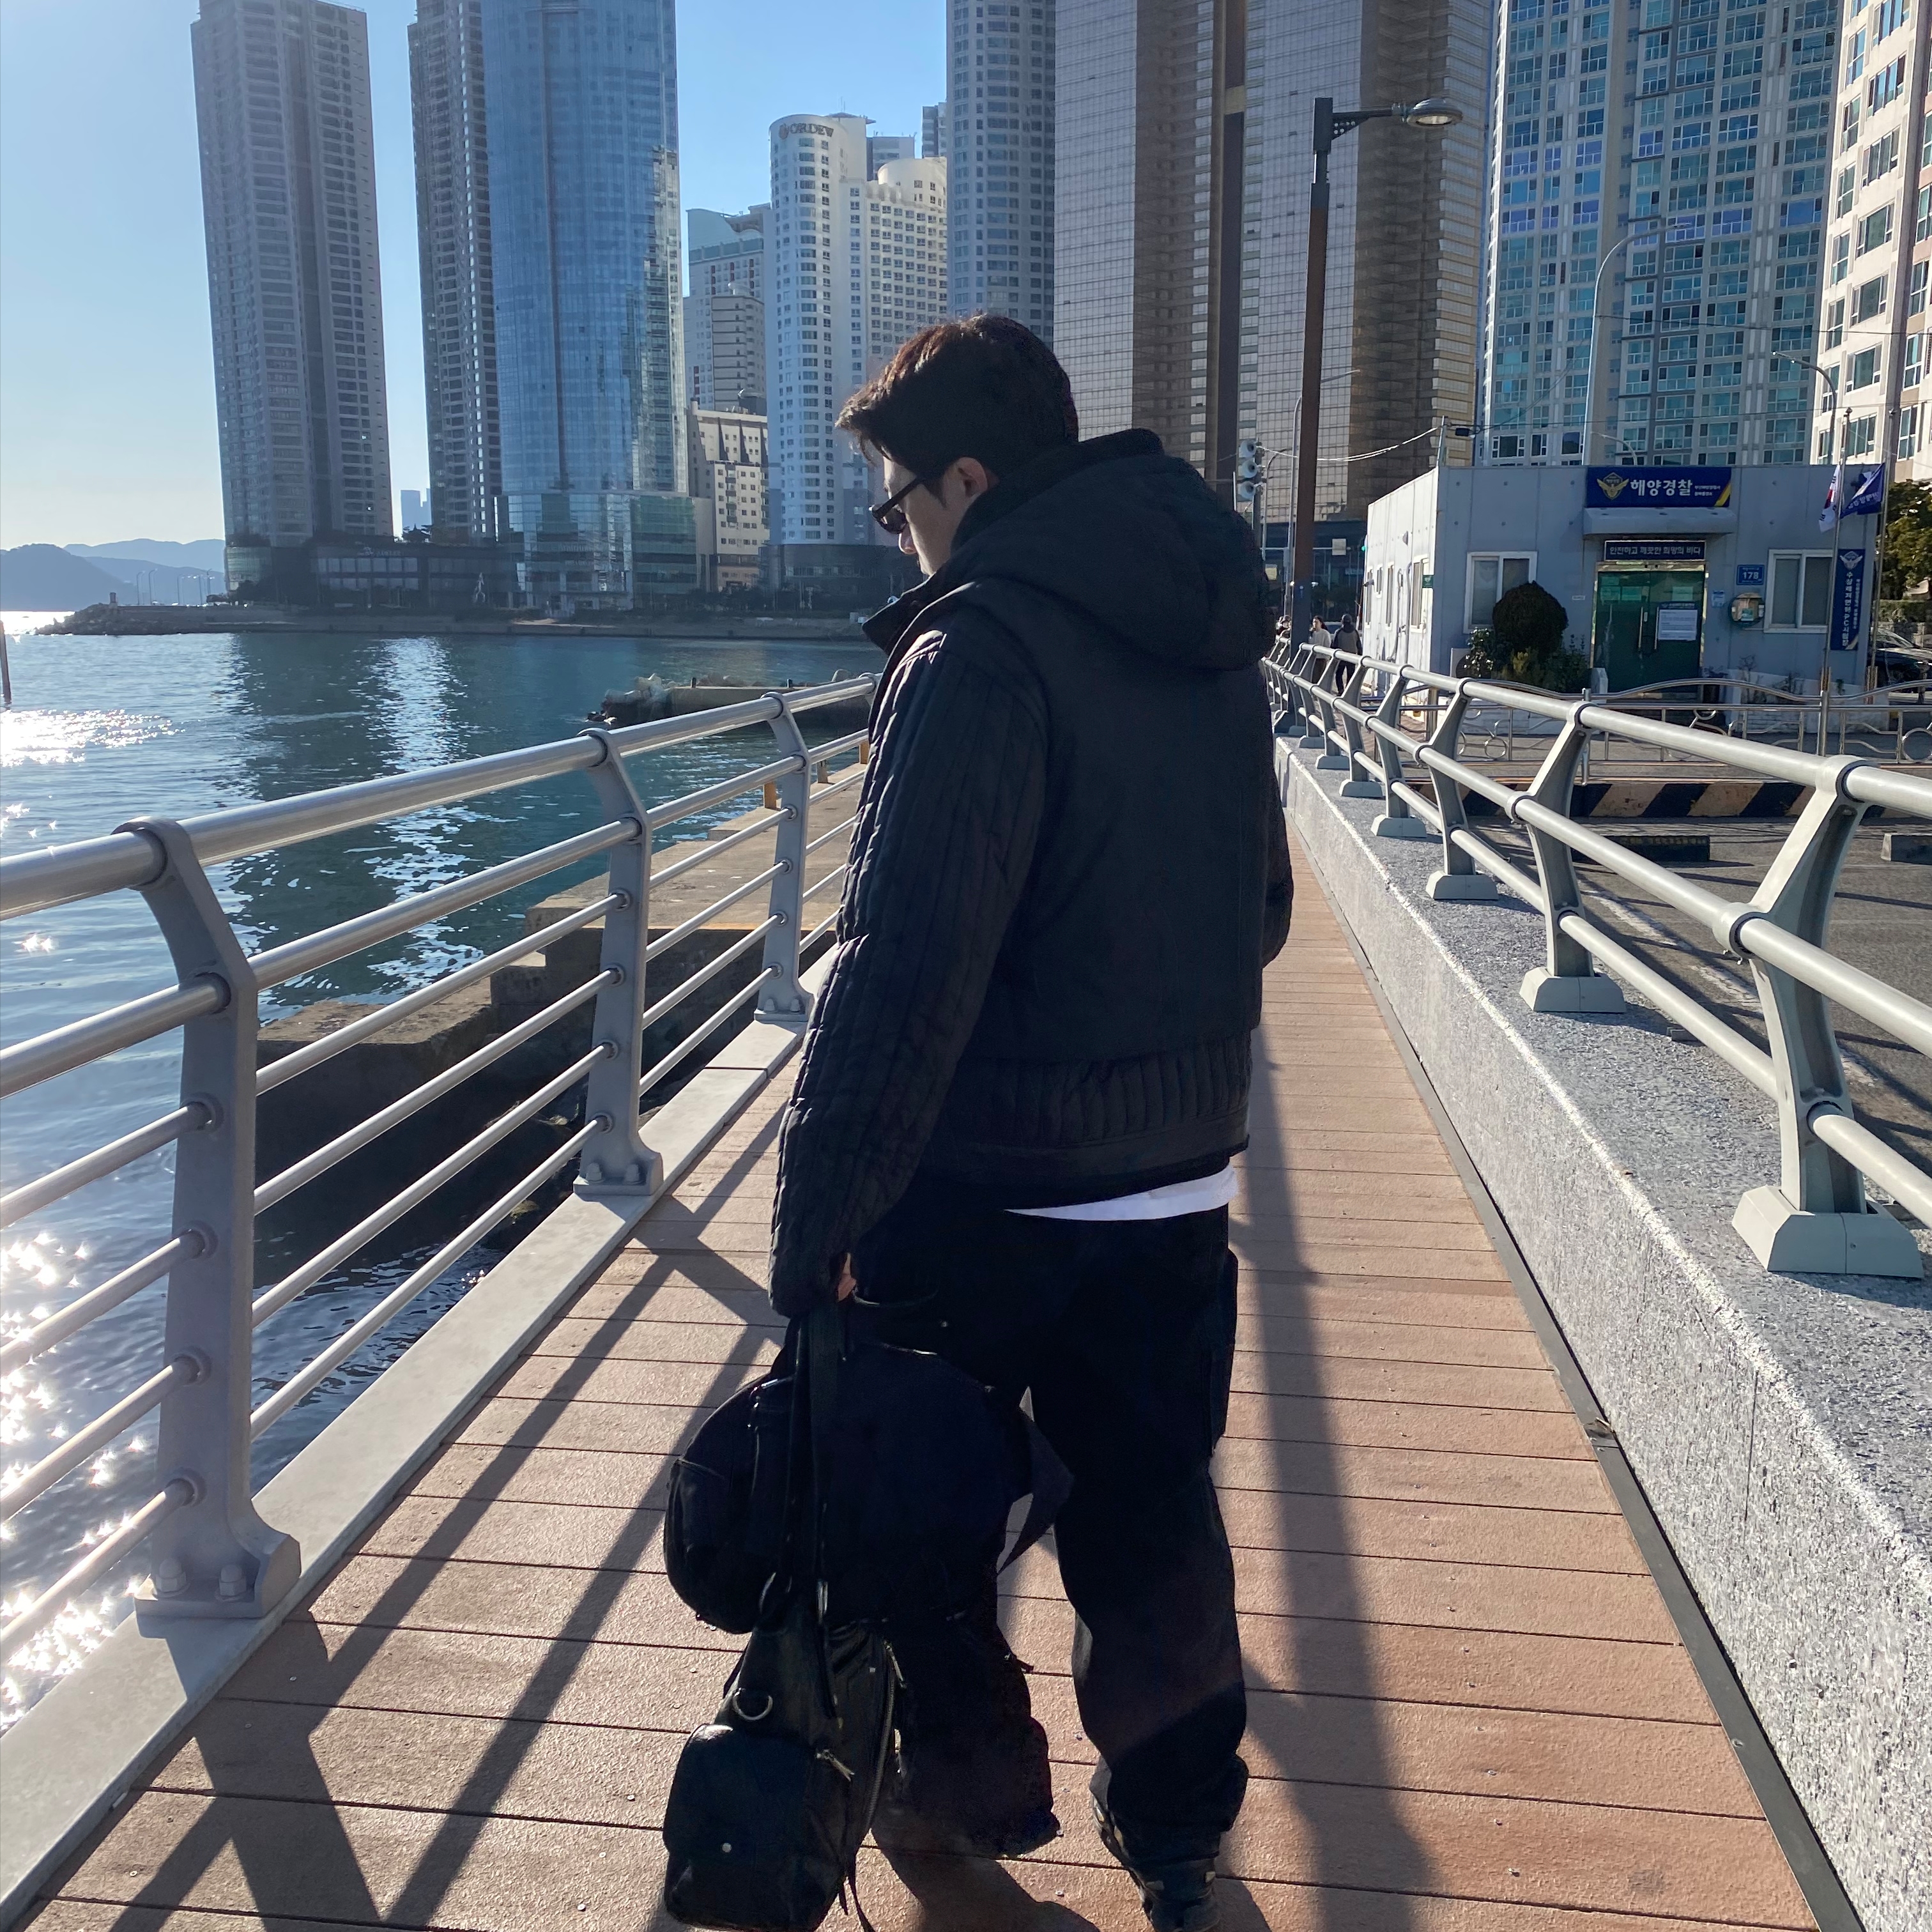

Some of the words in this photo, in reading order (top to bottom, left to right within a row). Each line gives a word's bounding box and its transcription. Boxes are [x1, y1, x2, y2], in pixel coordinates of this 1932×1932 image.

[1630, 479, 1692, 496] 해양경찰
[1609, 546, 1638, 555] 안전하고
[1639, 546, 1661, 555] 깨끗한
[1663, 546, 1684, 555] 희망의
[1686, 546, 1701, 555] 바다
